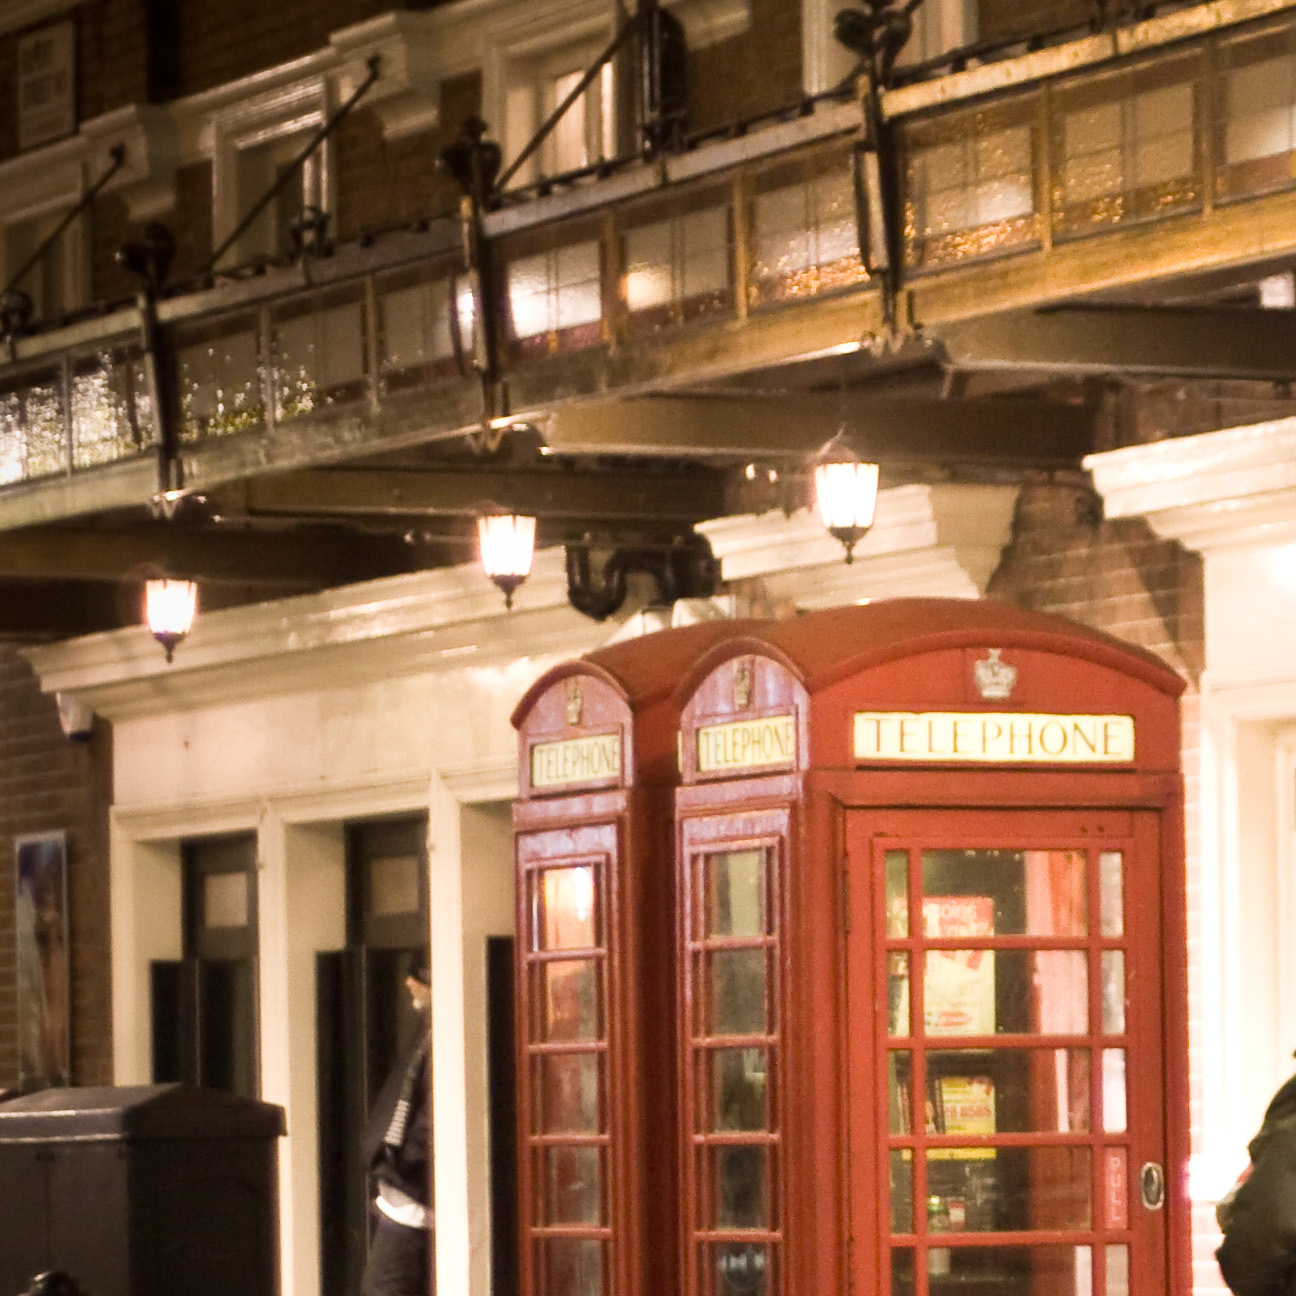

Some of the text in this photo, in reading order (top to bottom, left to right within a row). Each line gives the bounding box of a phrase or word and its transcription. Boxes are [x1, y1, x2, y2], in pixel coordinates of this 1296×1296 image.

[536, 737, 619, 782] TELEPHONE
[702, 719, 794, 768] TELEPHONE
[864, 717, 1126, 757] TELEPHONE
